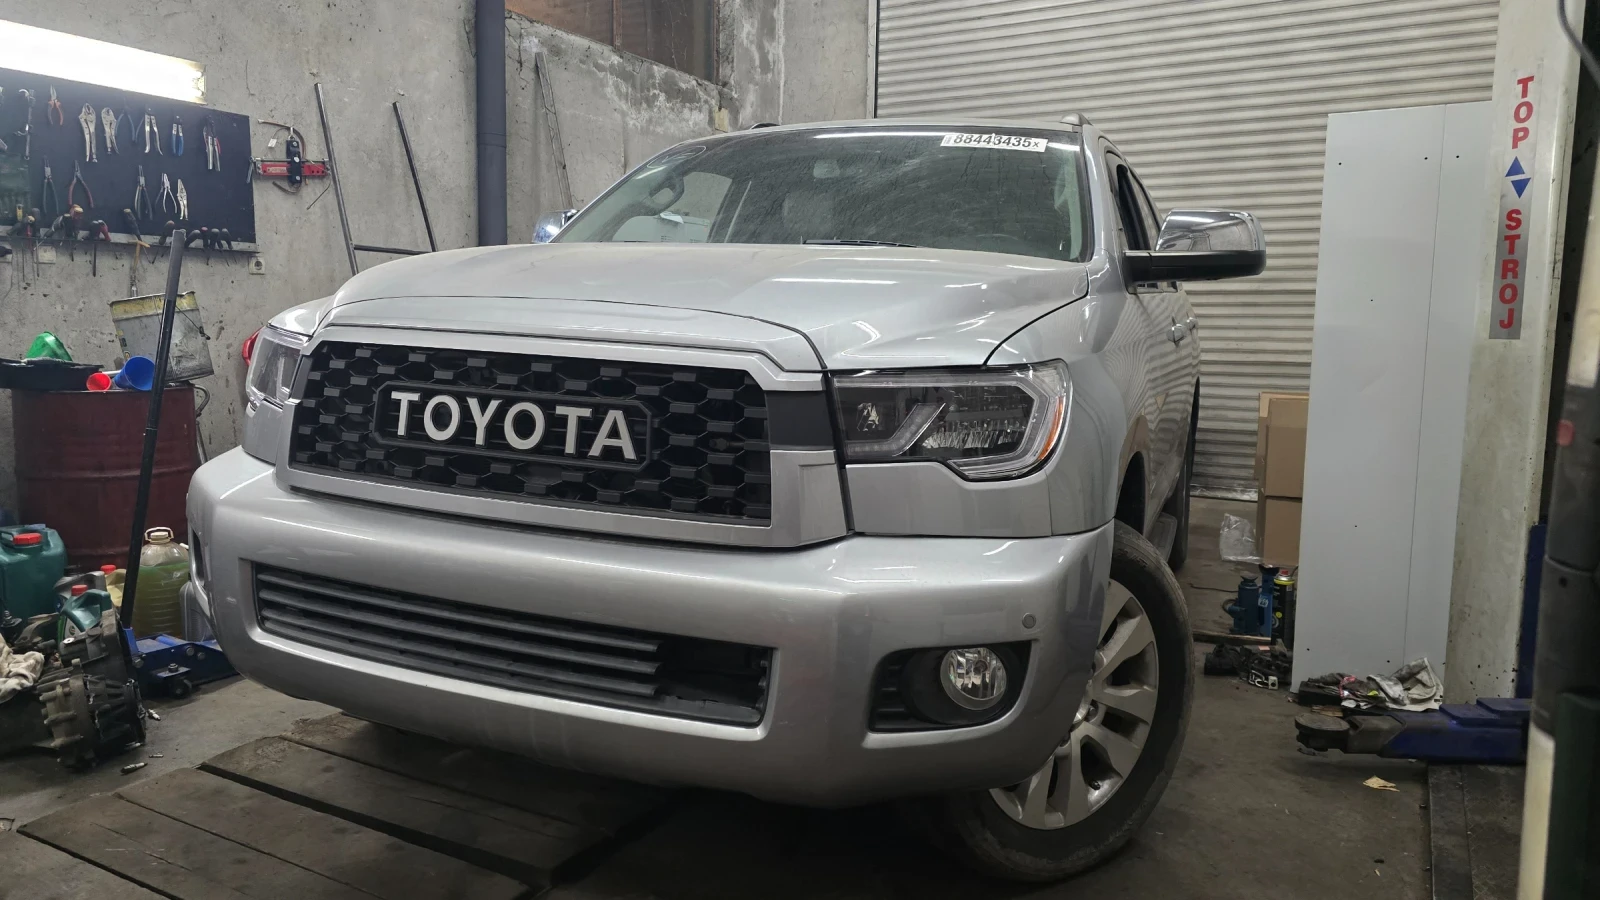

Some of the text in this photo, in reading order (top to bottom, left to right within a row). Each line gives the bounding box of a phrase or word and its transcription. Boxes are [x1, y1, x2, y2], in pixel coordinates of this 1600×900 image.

[1499, 75, 1534, 330] TOP STROJ
[391, 391, 638, 460] TOYOTA
